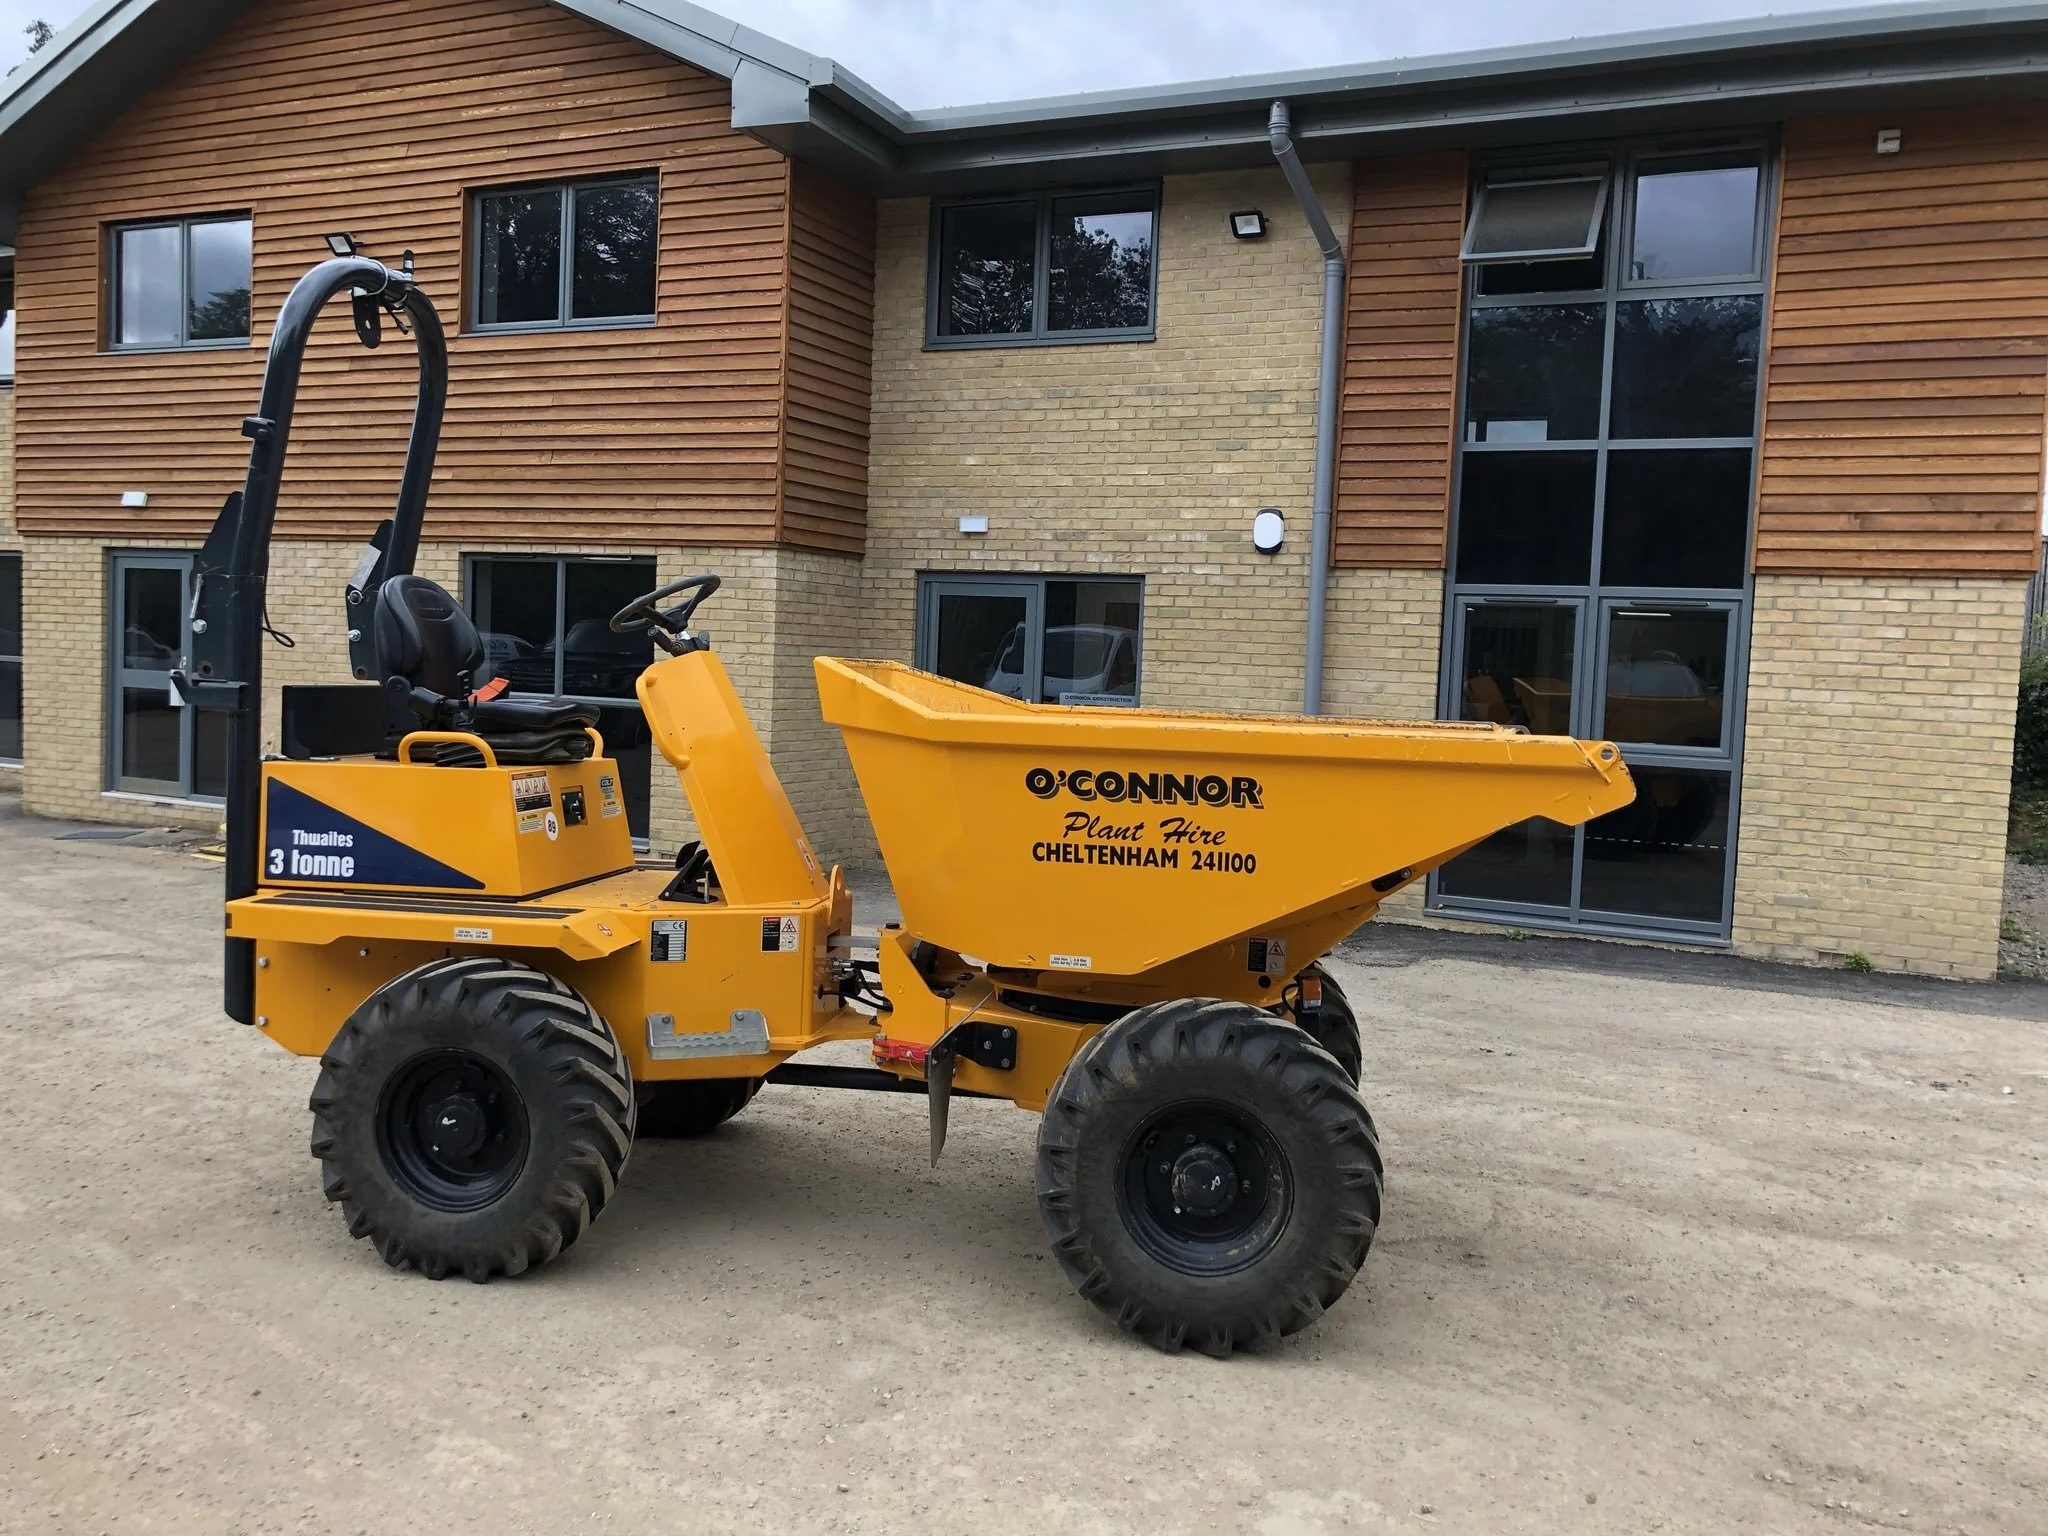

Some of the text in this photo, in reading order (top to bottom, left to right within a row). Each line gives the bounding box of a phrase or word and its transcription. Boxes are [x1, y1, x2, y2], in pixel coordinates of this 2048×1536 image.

[1025, 767, 1265, 809] O'CONNOR
[292, 829, 354, 847] Thwaites
[547, 819, 556, 834] 89
[1063, 811, 1226, 846] Plant Hire
[269, 848, 355, 877] 3 tonne
[1032, 842, 1257, 875] CHELTENHAM 241100
